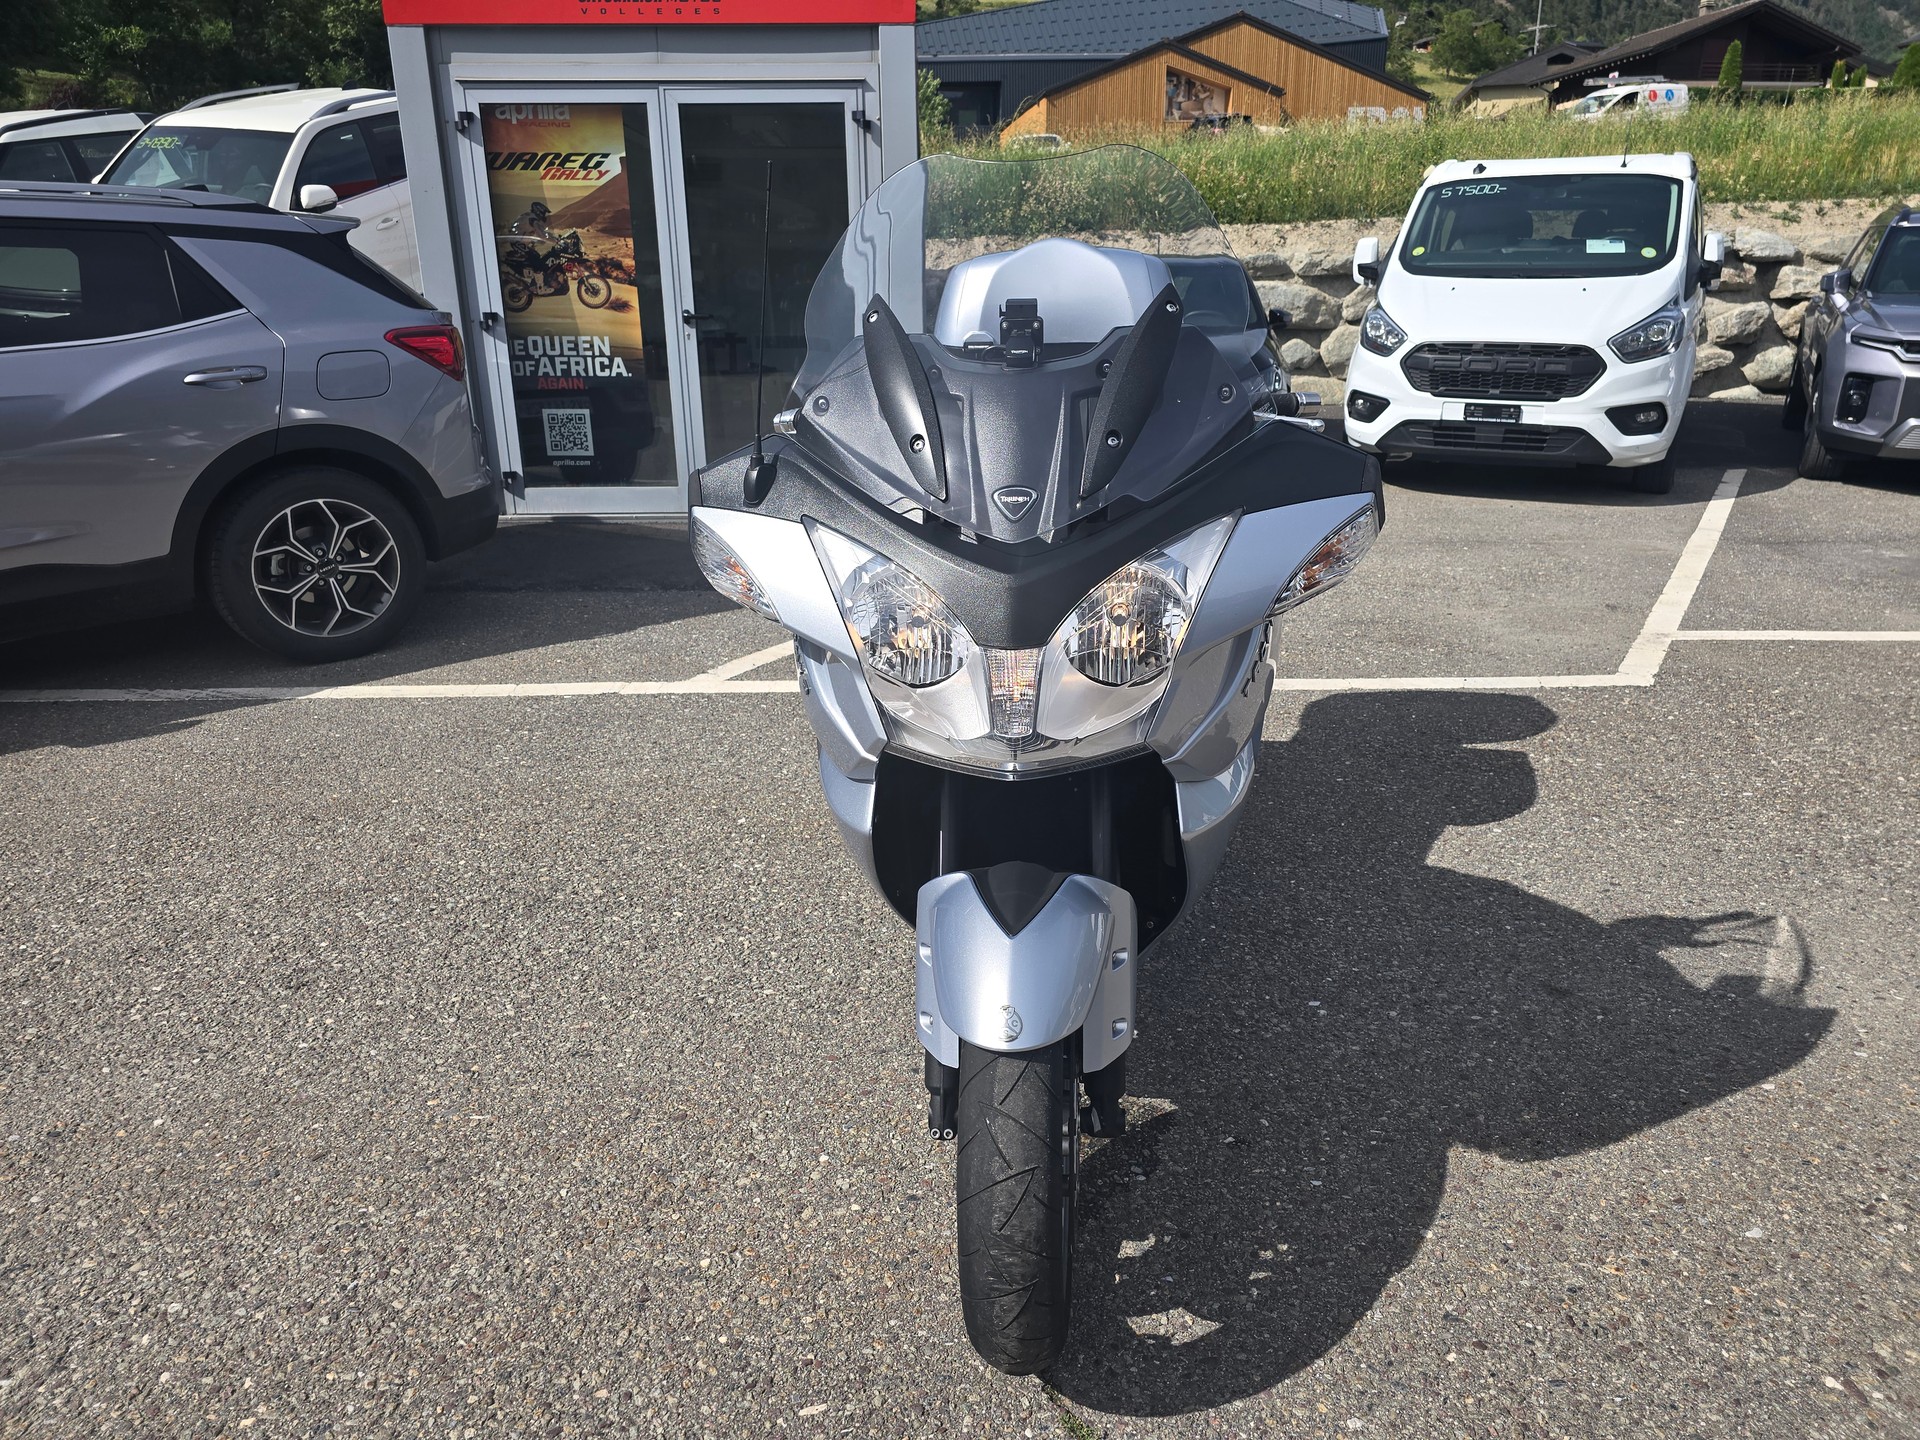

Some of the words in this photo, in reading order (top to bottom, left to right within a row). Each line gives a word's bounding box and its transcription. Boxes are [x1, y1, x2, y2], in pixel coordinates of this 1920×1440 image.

[580, 7, 721, 15] VOLLEGES
[488, 151, 612, 171] UAREG
[538, 167, 611, 181] RALLY
[527, 335, 611, 359] QUEEN
[512, 360, 536, 377] OF
[537, 356, 633, 377] AFRICA.
[1428, 355, 1570, 375] FORD
[537, 377, 589, 390] AGAIN.
[552, 458, 591, 467] aprilia.com
